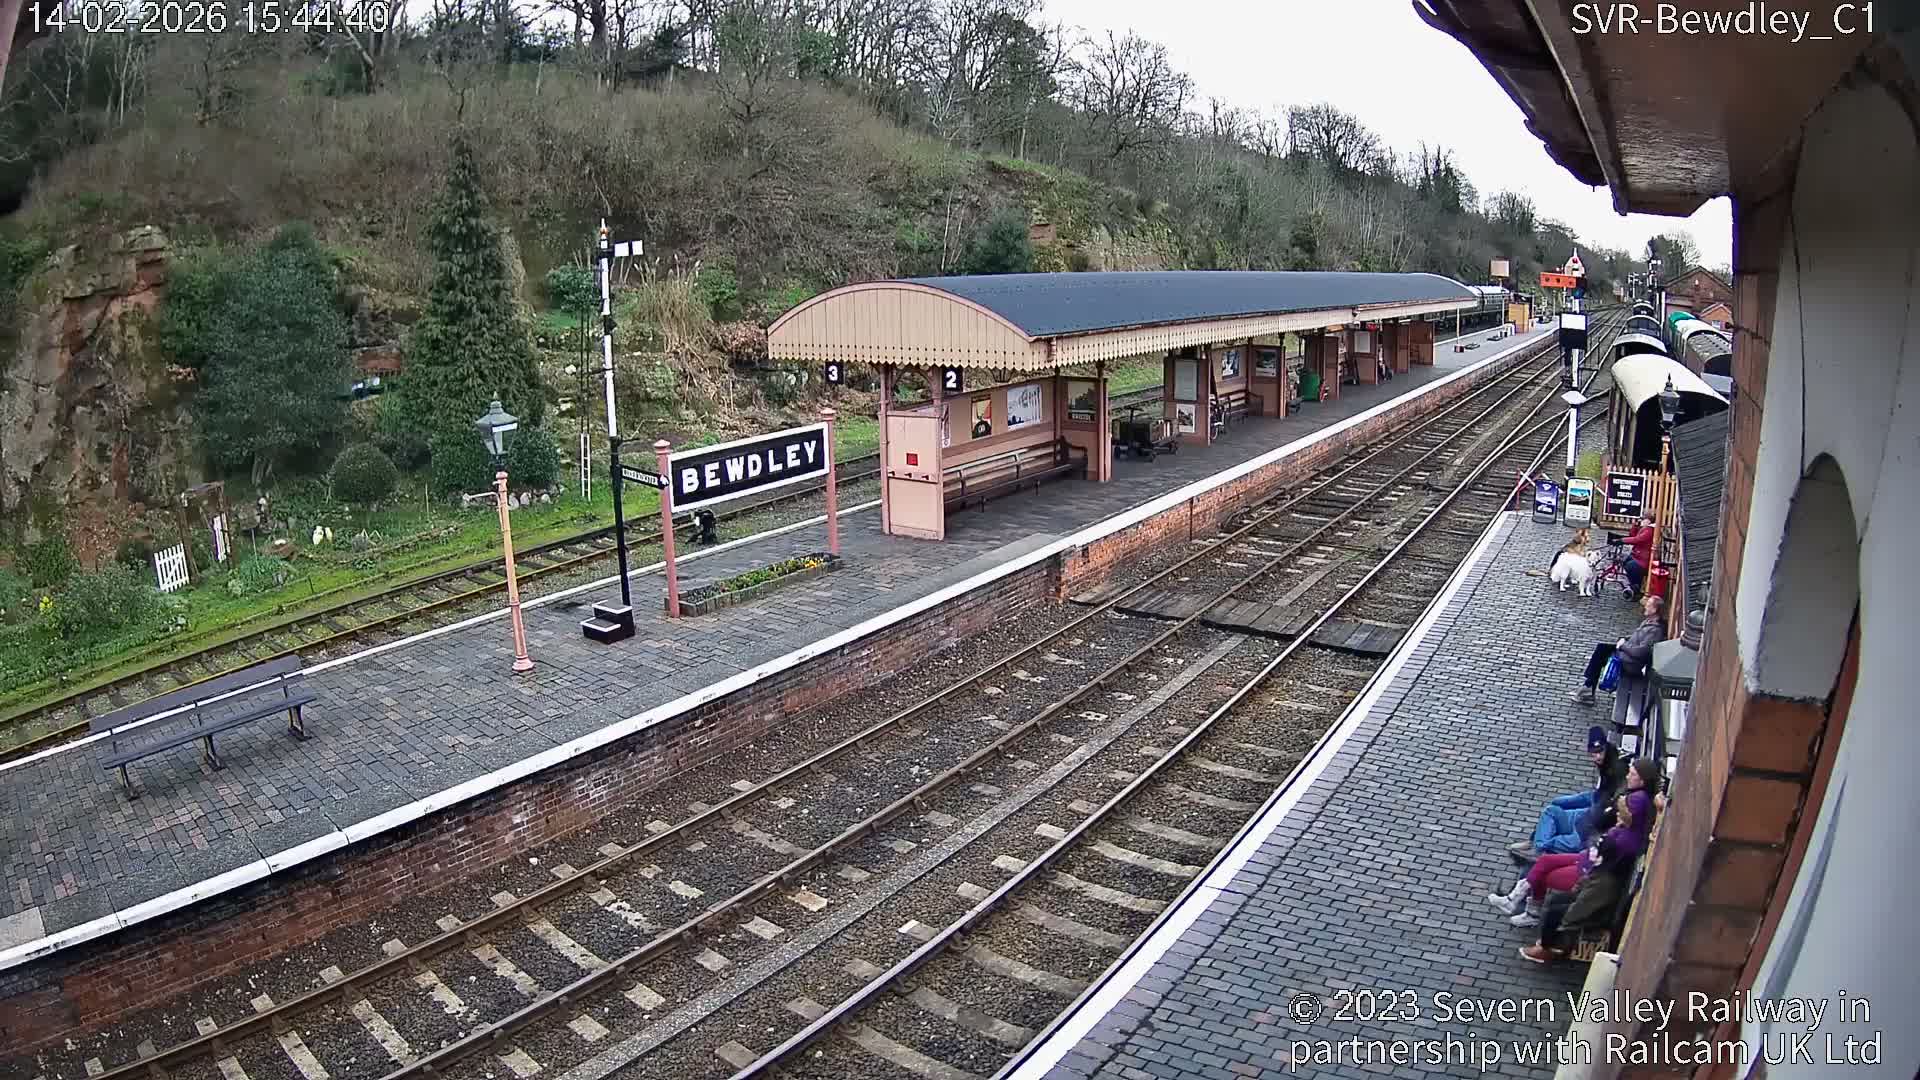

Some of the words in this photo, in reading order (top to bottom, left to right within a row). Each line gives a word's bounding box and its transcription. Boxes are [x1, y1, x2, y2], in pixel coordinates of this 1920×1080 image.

[828, 365, 839, 382] 3
[945, 370, 957, 389] 2
[681, 440, 817, 495] BEWDLEY
